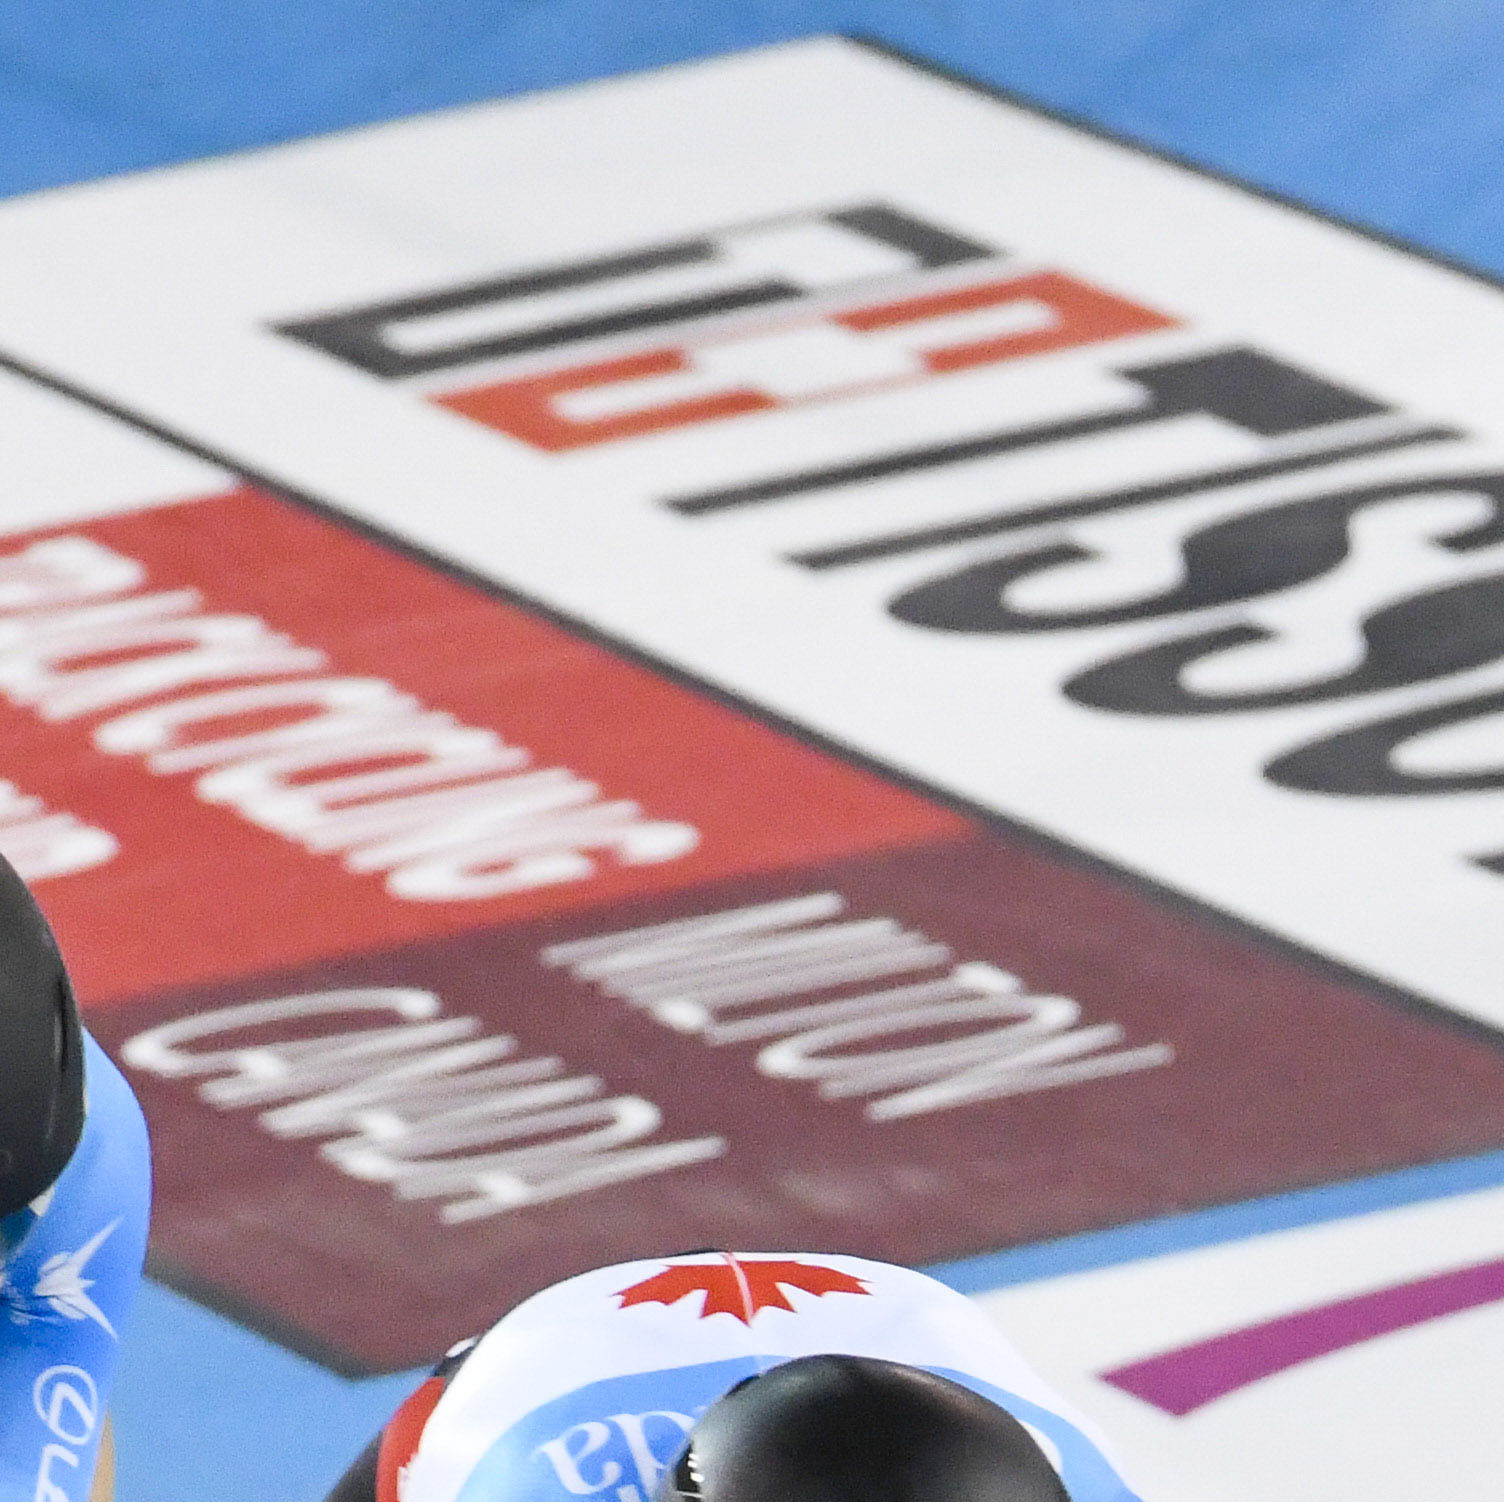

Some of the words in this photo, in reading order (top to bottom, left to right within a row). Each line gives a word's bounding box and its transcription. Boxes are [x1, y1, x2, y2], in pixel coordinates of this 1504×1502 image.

[94, 674, 700, 903] CYCLING
[120, 986, 728, 1225] CANADA
[537, 890, 1174, 1121] MILTON
